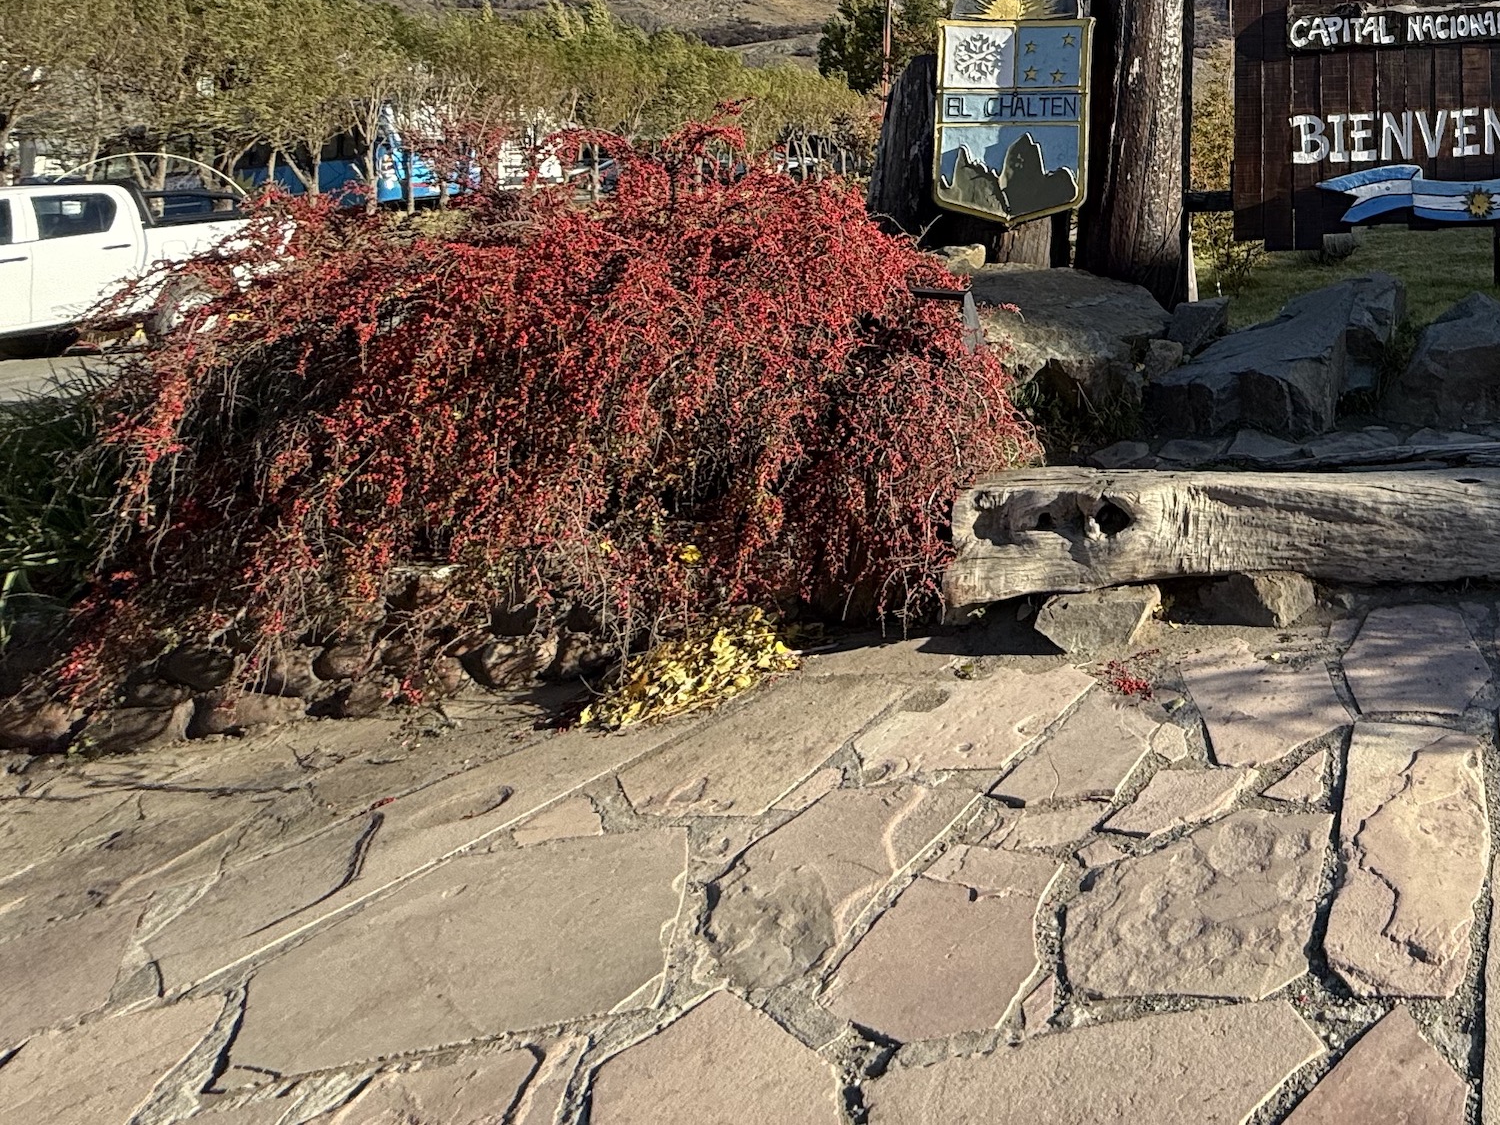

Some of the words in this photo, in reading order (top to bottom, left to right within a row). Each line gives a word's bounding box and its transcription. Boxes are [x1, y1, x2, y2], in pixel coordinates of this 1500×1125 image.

[1289, 15, 1394, 48] CAPITAL
[945, 96, 972, 117] EL
[983, 96, 1077, 117] CHALTEN
